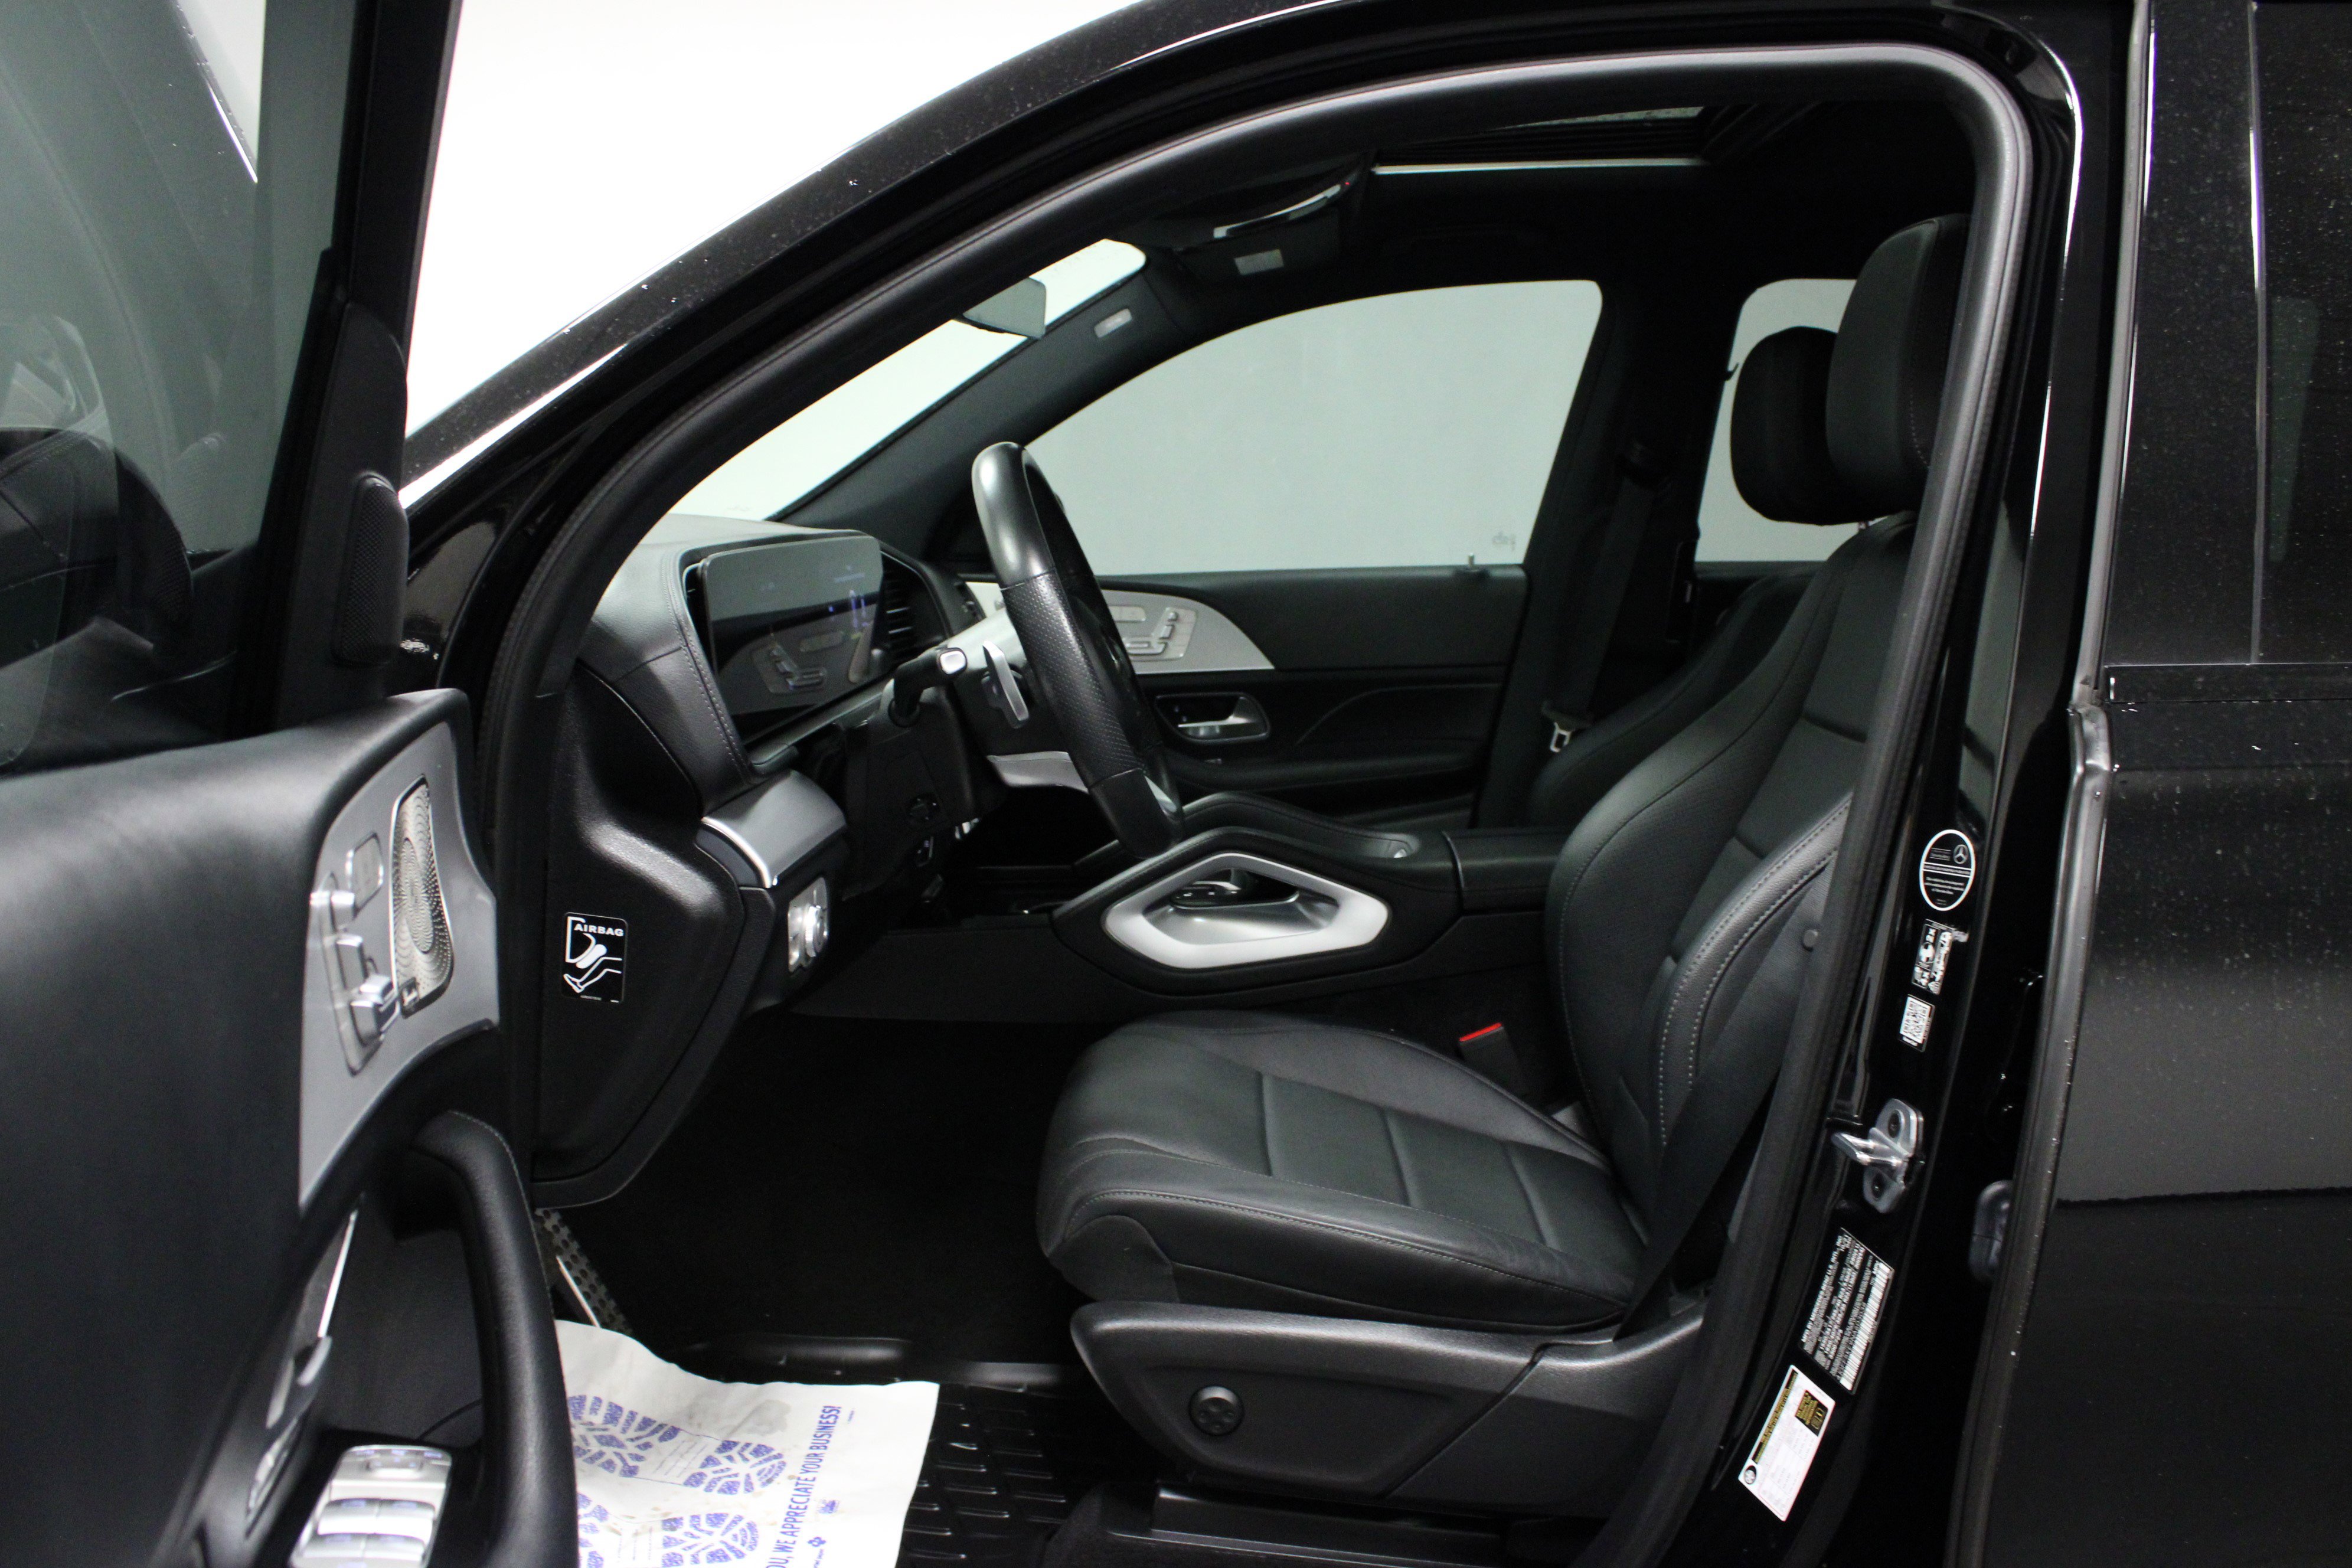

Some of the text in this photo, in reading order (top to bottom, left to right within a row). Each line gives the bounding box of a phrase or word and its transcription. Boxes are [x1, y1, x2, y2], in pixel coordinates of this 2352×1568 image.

[574, 923, 624, 937] AIRBAG
[809, 1405, 842, 1451] BUSINESS!
[800, 1452, 826, 1475] YOUR
[780, 1476, 816, 1537] APPRECIATE
[772, 1539, 796, 1553] WE
